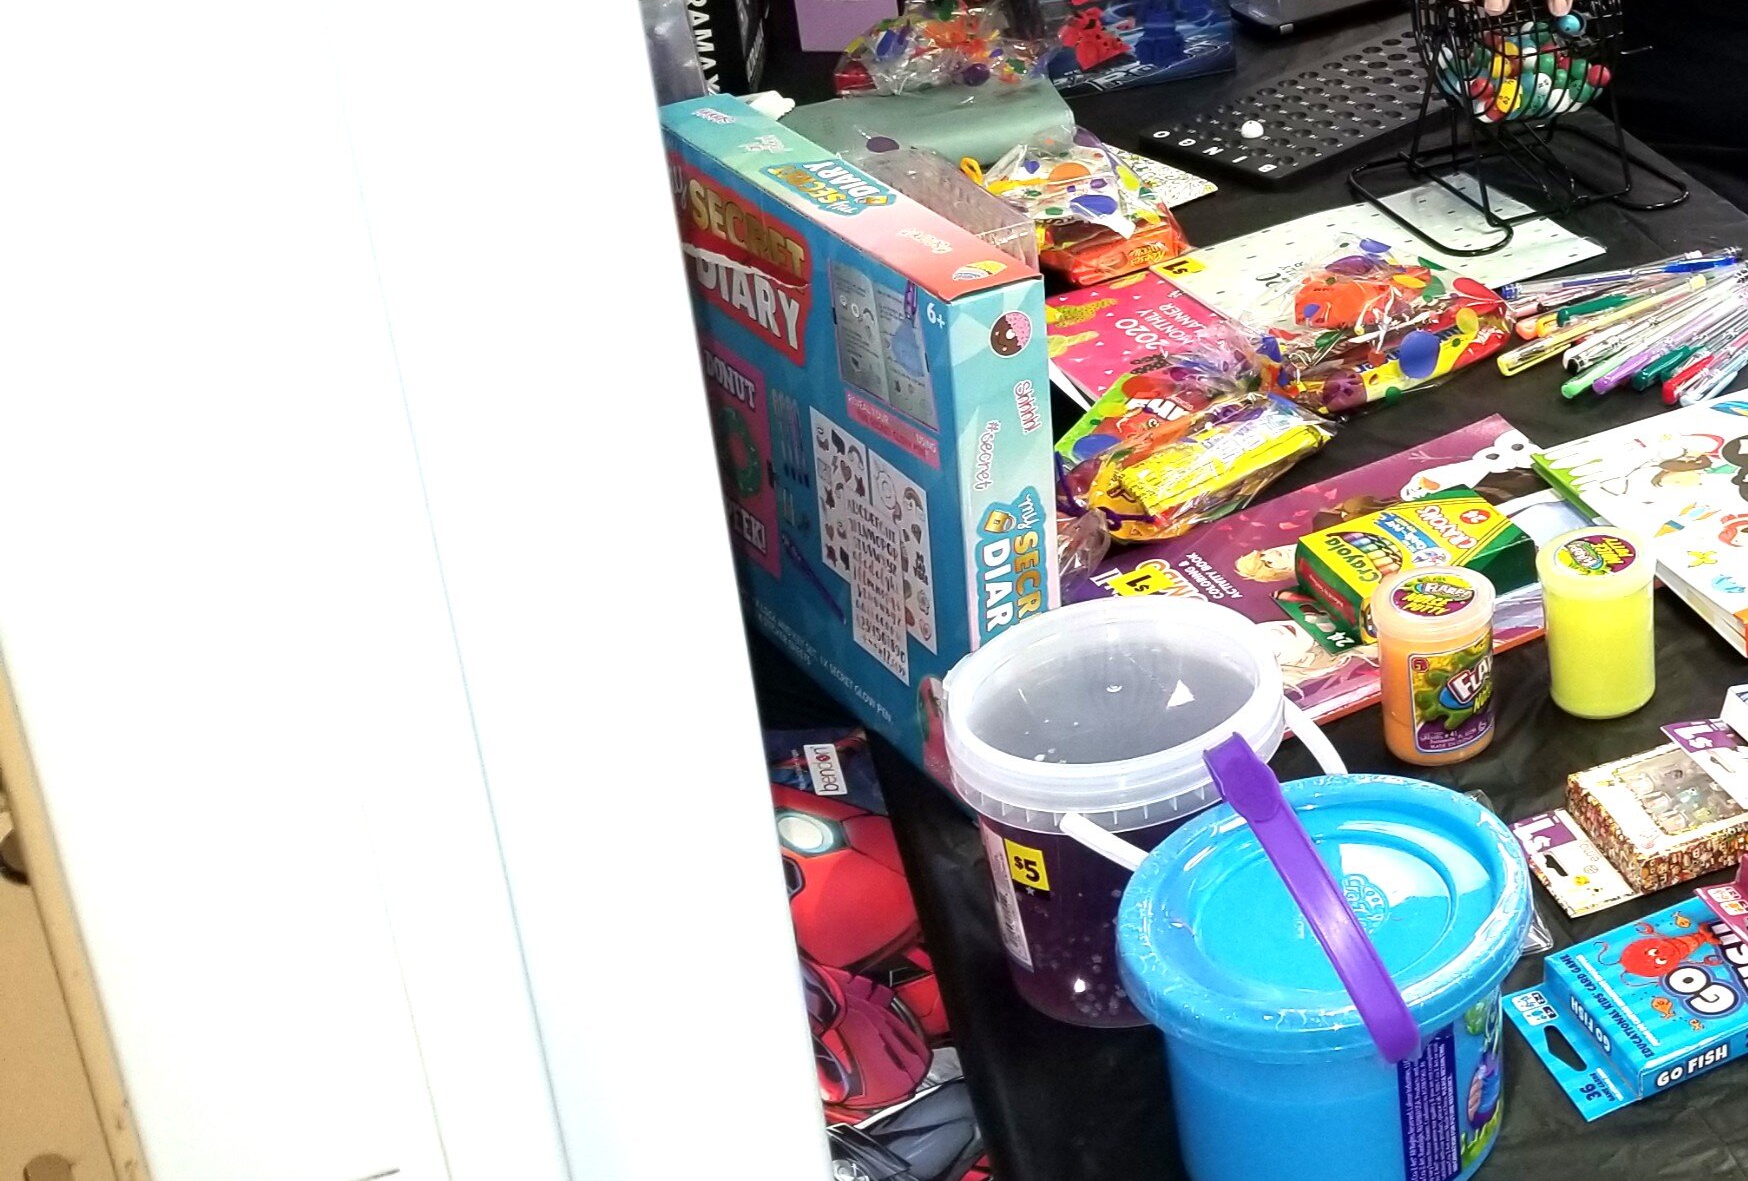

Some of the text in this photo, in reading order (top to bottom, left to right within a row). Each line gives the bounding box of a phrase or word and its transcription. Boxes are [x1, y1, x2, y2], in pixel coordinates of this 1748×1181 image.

[802, 162, 882, 204] DIARY
[689, 178, 805, 276] SECRET
[1162, 259, 1189, 276] $1
[696, 255, 801, 350] DIARY
[926, 302, 946, 330] 6+
[1115, 317, 1170, 352] 2020
[1135, 308, 1194, 345] MONTHLY
[703, 349, 757, 410] DONUT
[974, 420, 1001, 491] #secret
[1415, 505, 1479, 550] CRAYONS
[1013, 493, 1041, 625] my SECR
[1186, 552, 1208, 571] BOOK
[1324, 536, 1381, 584] Crayola
[981, 537, 1015, 635] DIAR
[1126, 574, 1151, 592] $1
[1184, 565, 1226, 600] COLORING
[1207, 569, 1243, 600] ACTIVITY
[1327, 631, 1355, 648] 24
[829, 665, 854, 690] SECRET
[876, 704, 892, 723] PEN
[818, 744, 841, 794] bendon
[1013, 855, 1040, 883] $5
[1560, 954, 1655, 1058] EDUCATIONAL KIDS' CARD GAME
[1668, 966, 1738, 1016] GO
[1571, 995, 1611, 1054] GO FISH
[1657, 1044, 1728, 1087] GO FISH
[1580, 1083, 1601, 1102] 36
